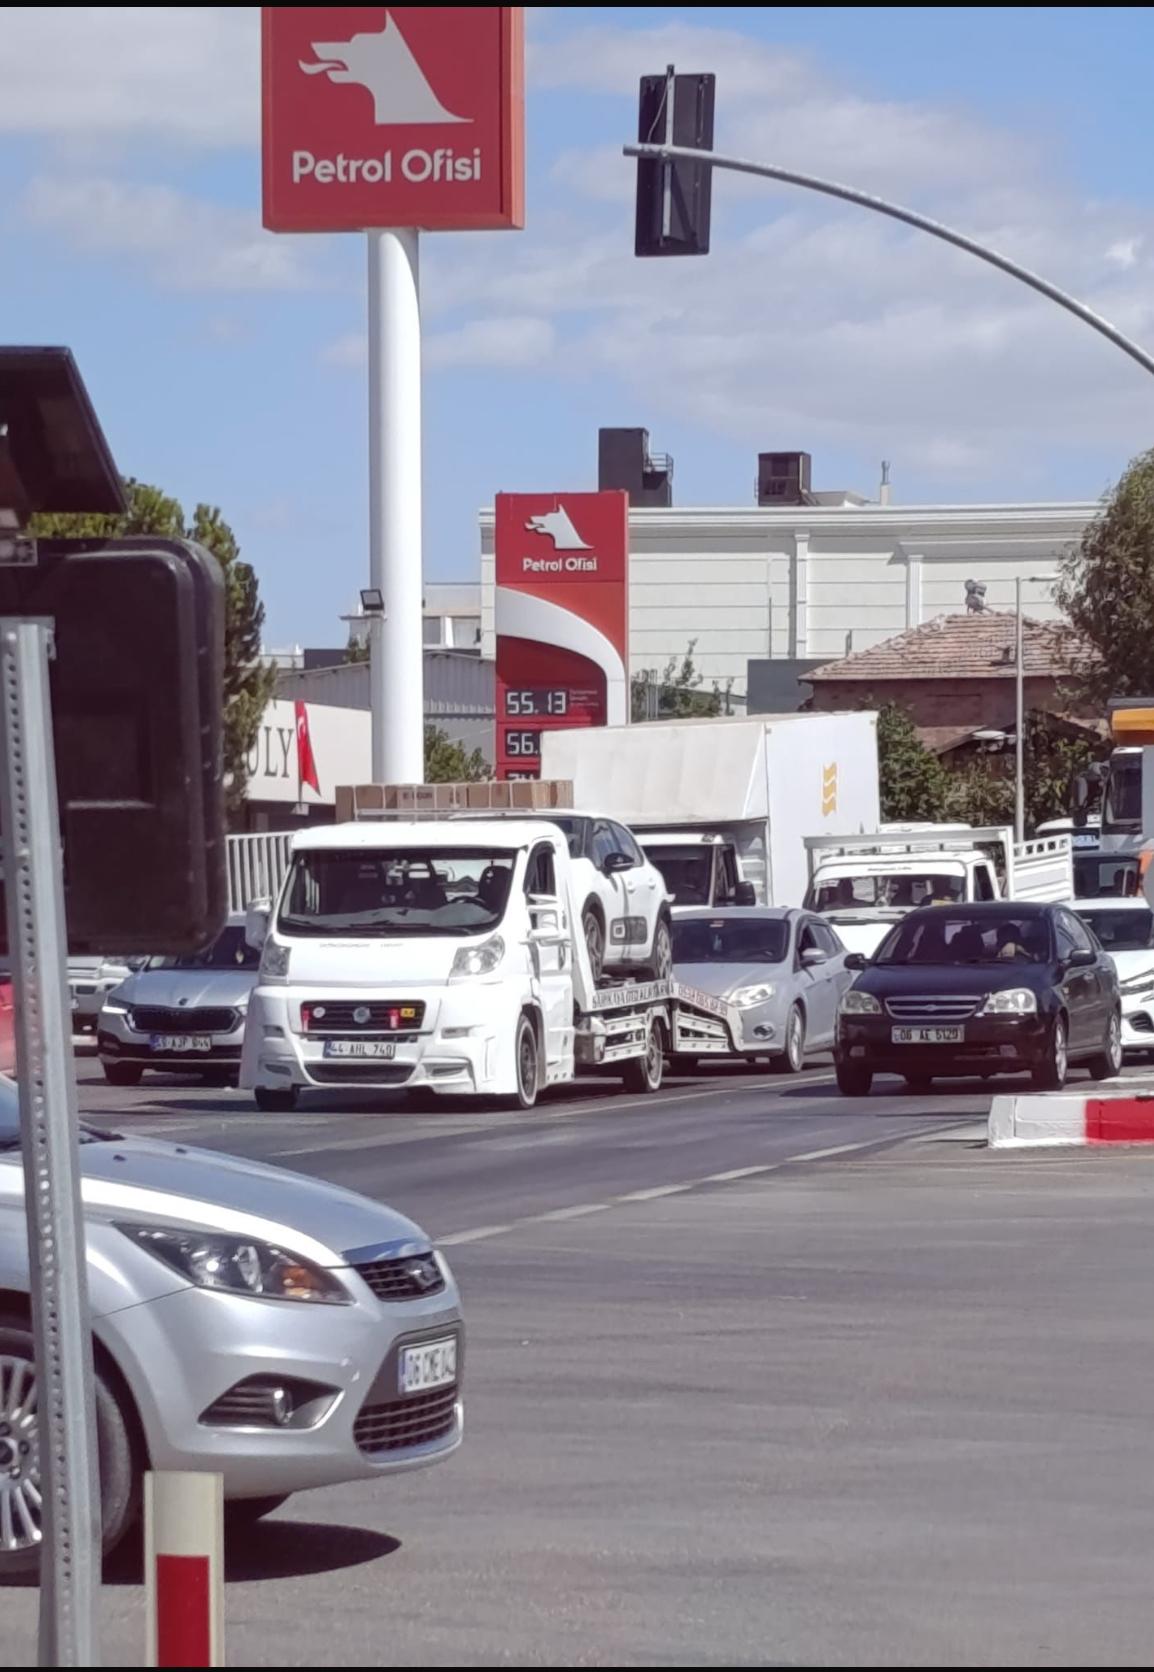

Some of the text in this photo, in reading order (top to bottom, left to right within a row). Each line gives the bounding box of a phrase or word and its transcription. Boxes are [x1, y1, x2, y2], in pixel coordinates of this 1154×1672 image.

[292, 148, 481, 183] Petrol Ofisi
[523, 557, 597, 572] Petrol Ofisi
